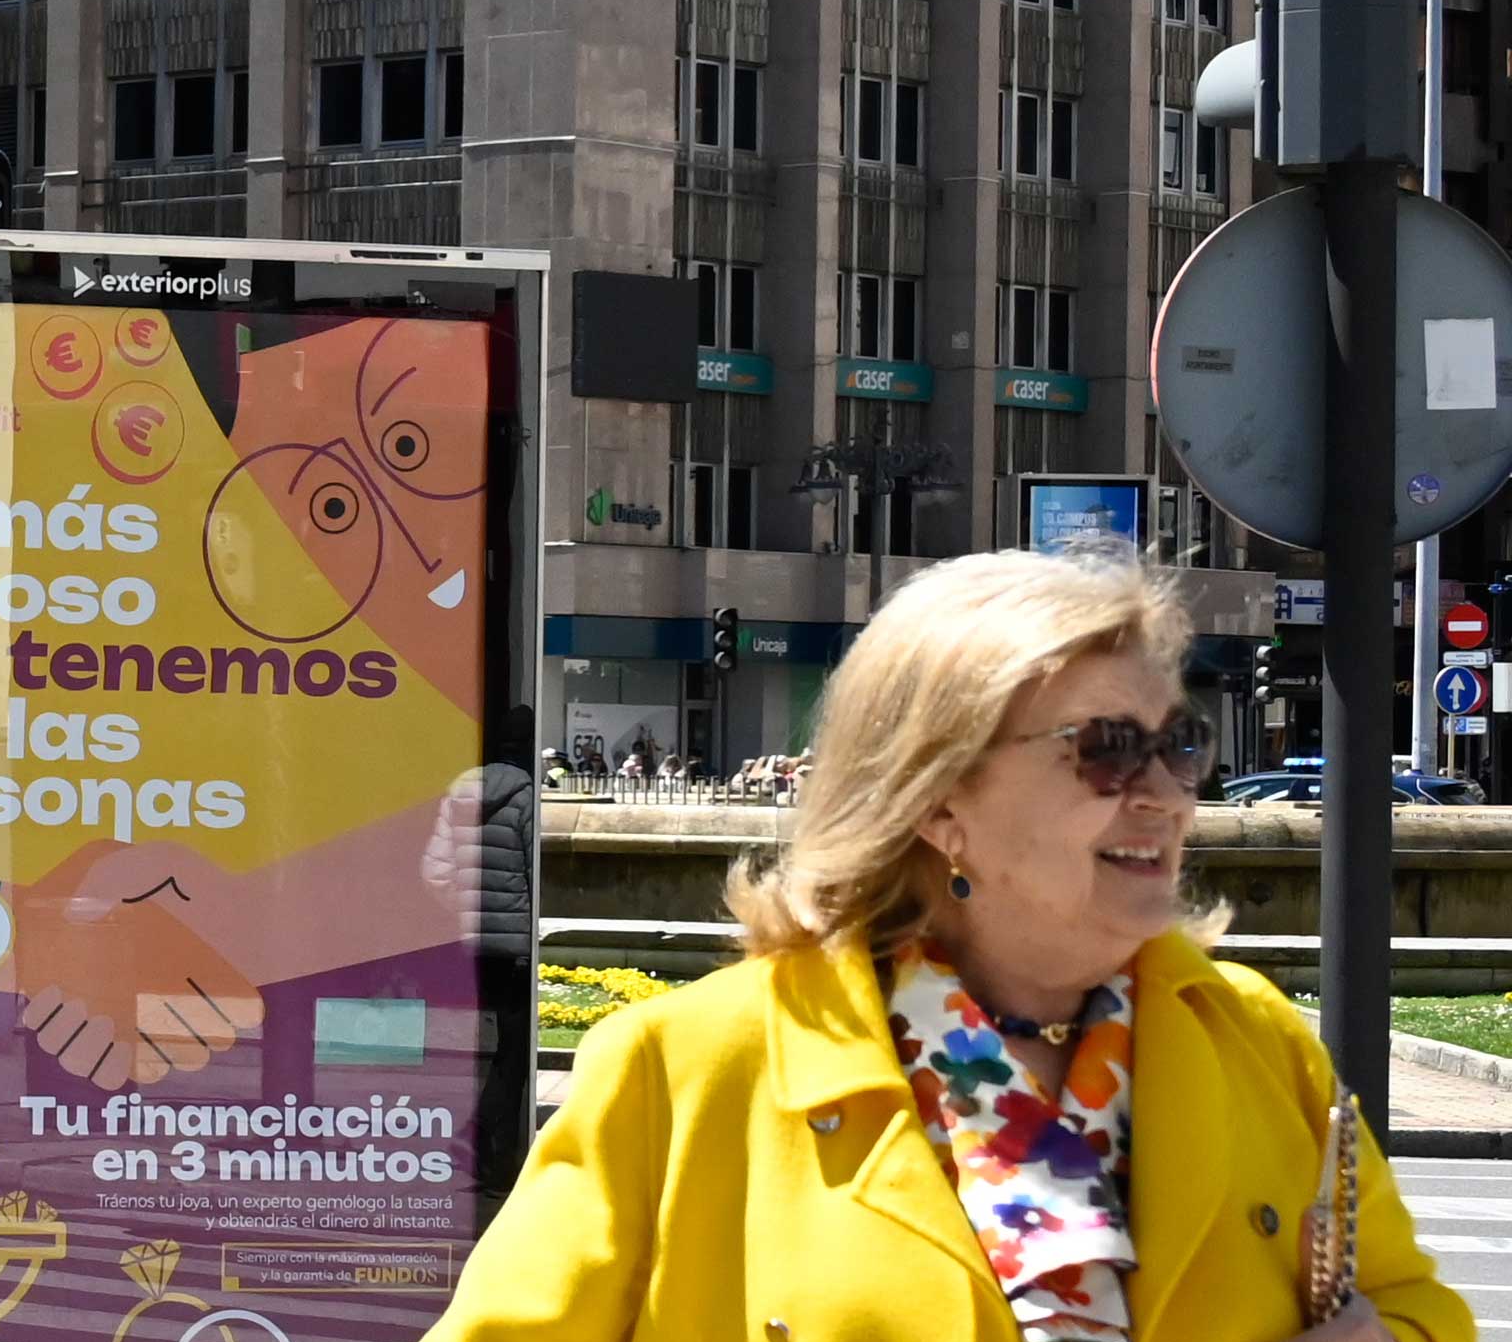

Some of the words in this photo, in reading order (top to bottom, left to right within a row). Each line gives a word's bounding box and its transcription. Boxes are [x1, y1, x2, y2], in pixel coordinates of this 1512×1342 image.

[101, 270, 252, 300] exteriorplus
[697, 360, 732, 383] aser
[854, 369, 893, 392] caser
[1013, 378, 1049, 402] caser
[612, 503, 662, 530] Unicaja
[753, 637, 788, 656] Unicaja
[7, 629, 399, 699] tenemos
[6, 697, 141, 763] las
[19, 1095, 90, 1137] Tu
[100, 1092, 453, 1139] financiación
[92, 1147, 158, 1182] en
[170, 1140, 206, 1182] 3
[218, 1138, 453, 1183] minutos
[95, 1193, 156, 1210] Tráenos
[158, 1194, 176, 1209] tu
[177, 1193, 214, 1212] joya,
[217, 1197, 239, 1209] un
[242, 1195, 302, 1213] experto
[306, 1194, 386, 1213] gemólogo
[390, 1194, 404, 1209] la
[407, 1194, 453, 1210] tasará
[204, 1216, 215, 1231] y
[218, 1212, 298, 1229] obtendrás
[302, 1213, 316, 1228] el
[319, 1213, 369, 1229] dinero
[372, 1213, 386, 1229] al
[390, 1214, 454, 1229] instante.
[236, 1251, 287, 1265] Siempre
[289, 1253, 312, 1264] con
[314, 1252, 325, 1263] la
[327, 1251, 376, 1264] máxima
[378, 1251, 437, 1264] valoración
[270, 1269, 281, 1281] la
[284, 1269, 334, 1283] garantía
[335, 1269, 352, 1282] de
[354, 1267, 438, 1284] FUNDOS
